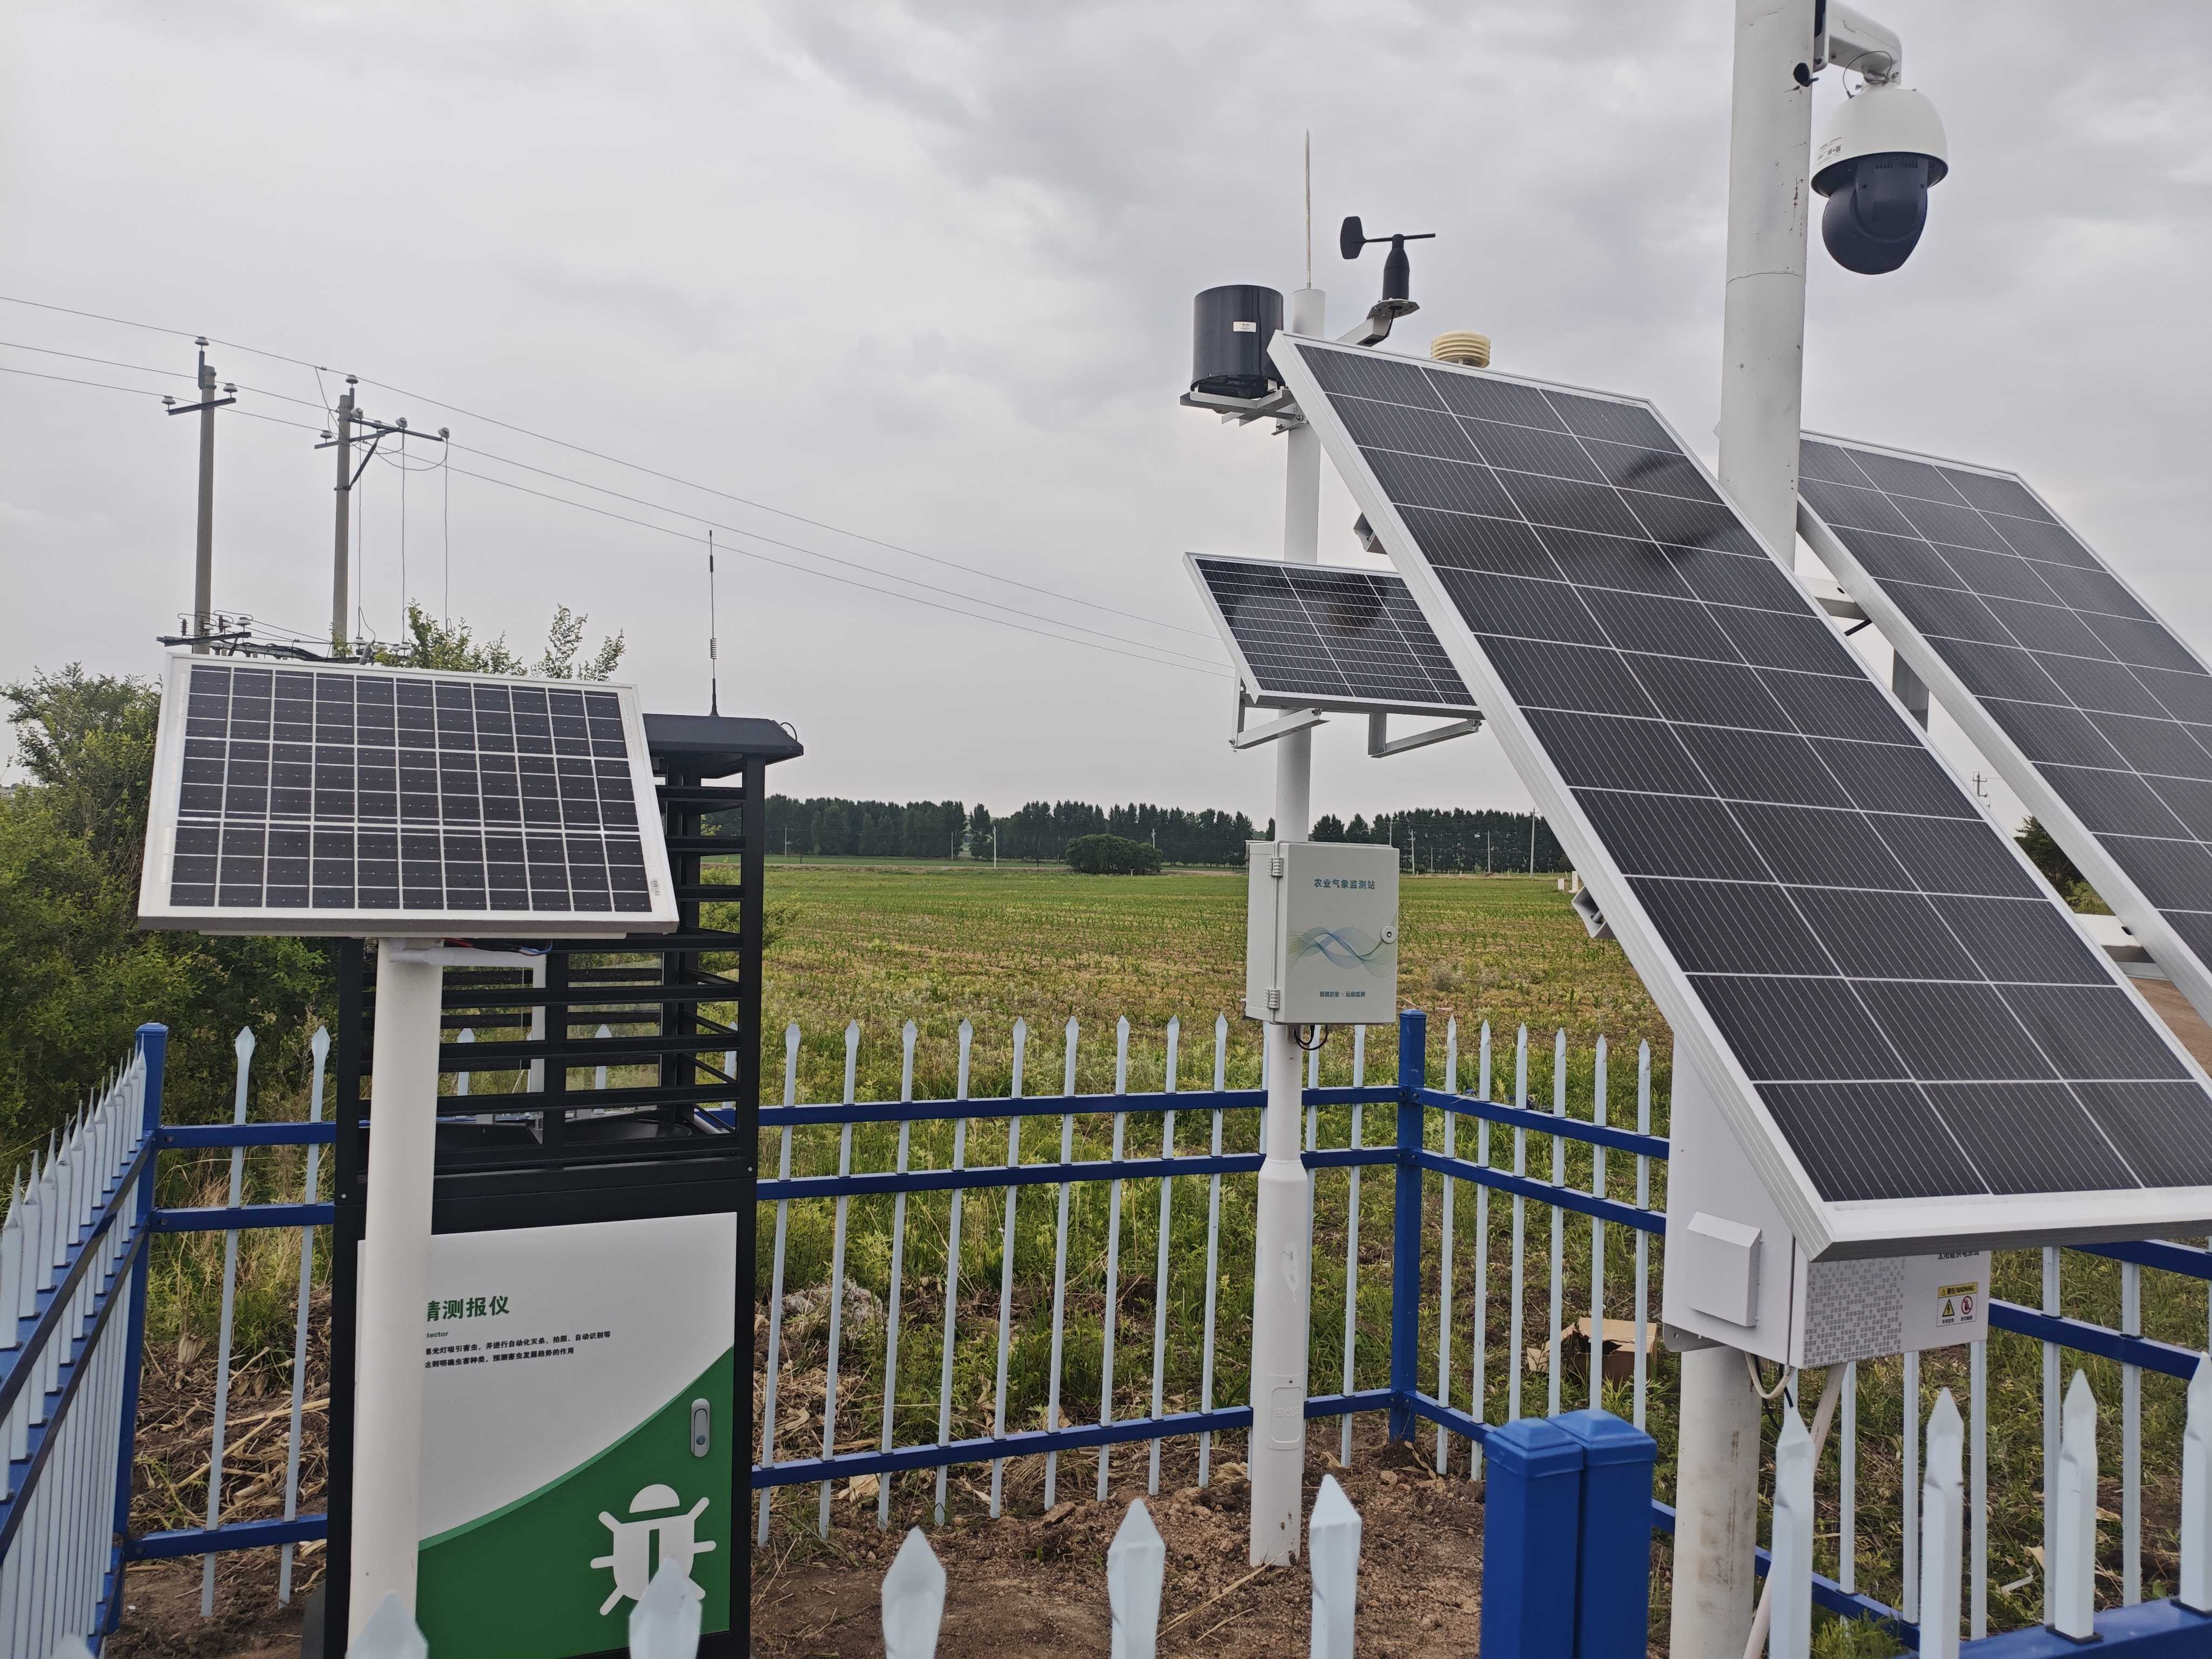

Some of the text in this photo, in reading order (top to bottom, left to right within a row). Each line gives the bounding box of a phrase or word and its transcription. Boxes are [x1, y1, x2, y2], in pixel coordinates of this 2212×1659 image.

[1313, 878, 1375, 889] 农业气象监测站
